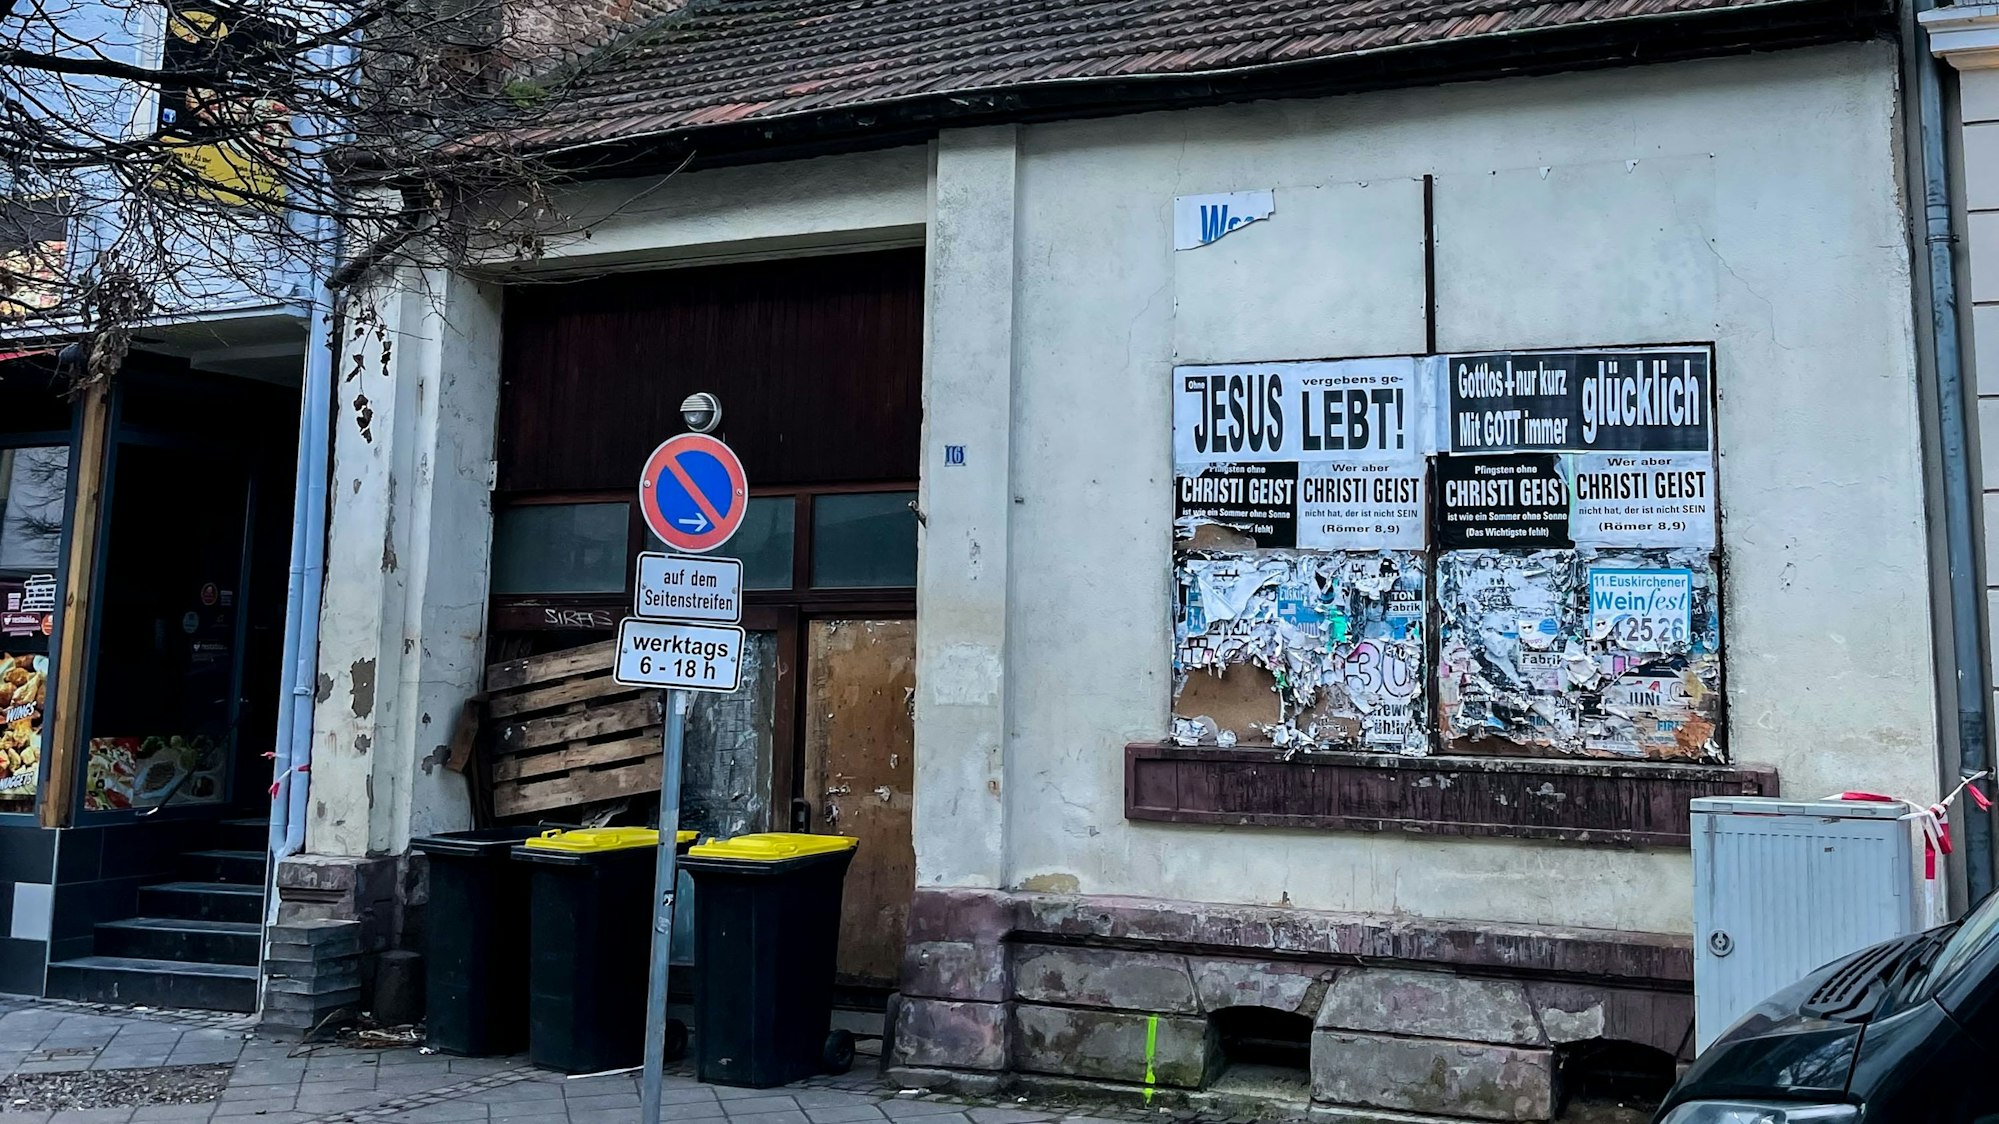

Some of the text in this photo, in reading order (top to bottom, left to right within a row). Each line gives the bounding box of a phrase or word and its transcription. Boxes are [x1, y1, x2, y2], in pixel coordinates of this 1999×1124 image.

[1302, 375, 1403, 387] vergebens ge-
[1458, 361, 1567, 398] Gottlos nur kurz
[1582, 359, 1700, 444] glücklich
[1194, 374, 1283, 453] JESUS
[1302, 388, 1404, 451] LEBT!
[1459, 409, 1568, 446] Mit GOTT immer
[948, 446, 962, 464] 16
[1607, 457, 1672, 466] Wer aber
[1247, 465, 1266, 473] ohne
[1332, 464, 1390, 472] Wer aber
[1474, 464, 1538, 476] Pfingsten ohne
[1182, 477, 1294, 505] CHRISTI GEIST
[1303, 477, 1419, 503] CHRISTI GEIST
[1445, 478, 1568, 507] CHRISTI GEIST
[1576, 471, 1706, 500] CHRISTI GEIST
[1182, 508, 1291, 519] ist wie ein Sommer ohne Sonne
[1305, 509, 1418, 518] nicht hat, der ist nicht SEIN
[1447, 511, 1567, 521] ist wie ein Sommer ohne Sonne
[1579, 504, 1706, 515] nicht hat, der ist nicht SEIN
[1322, 524, 1370, 534] (Römer
[1465, 527, 1549, 538] (Das Wichtigste fehlt)
[1599, 522, 1686, 532] (Römer 8,9)
[664, 569, 717, 588] auf dem
[644, 588, 733, 611] Seitenstreifen
[1392, 591, 1415, 601] TON
[1595, 588, 1687, 616] Weinfest
[1387, 603, 1421, 612] Fabrik
[633, 635, 729, 661] werktags
[640, 656, 652, 675] 6
[674, 659, 697, 678] 18
[703, 661, 716, 680] h
[6, 701, 37, 723] WINGS
